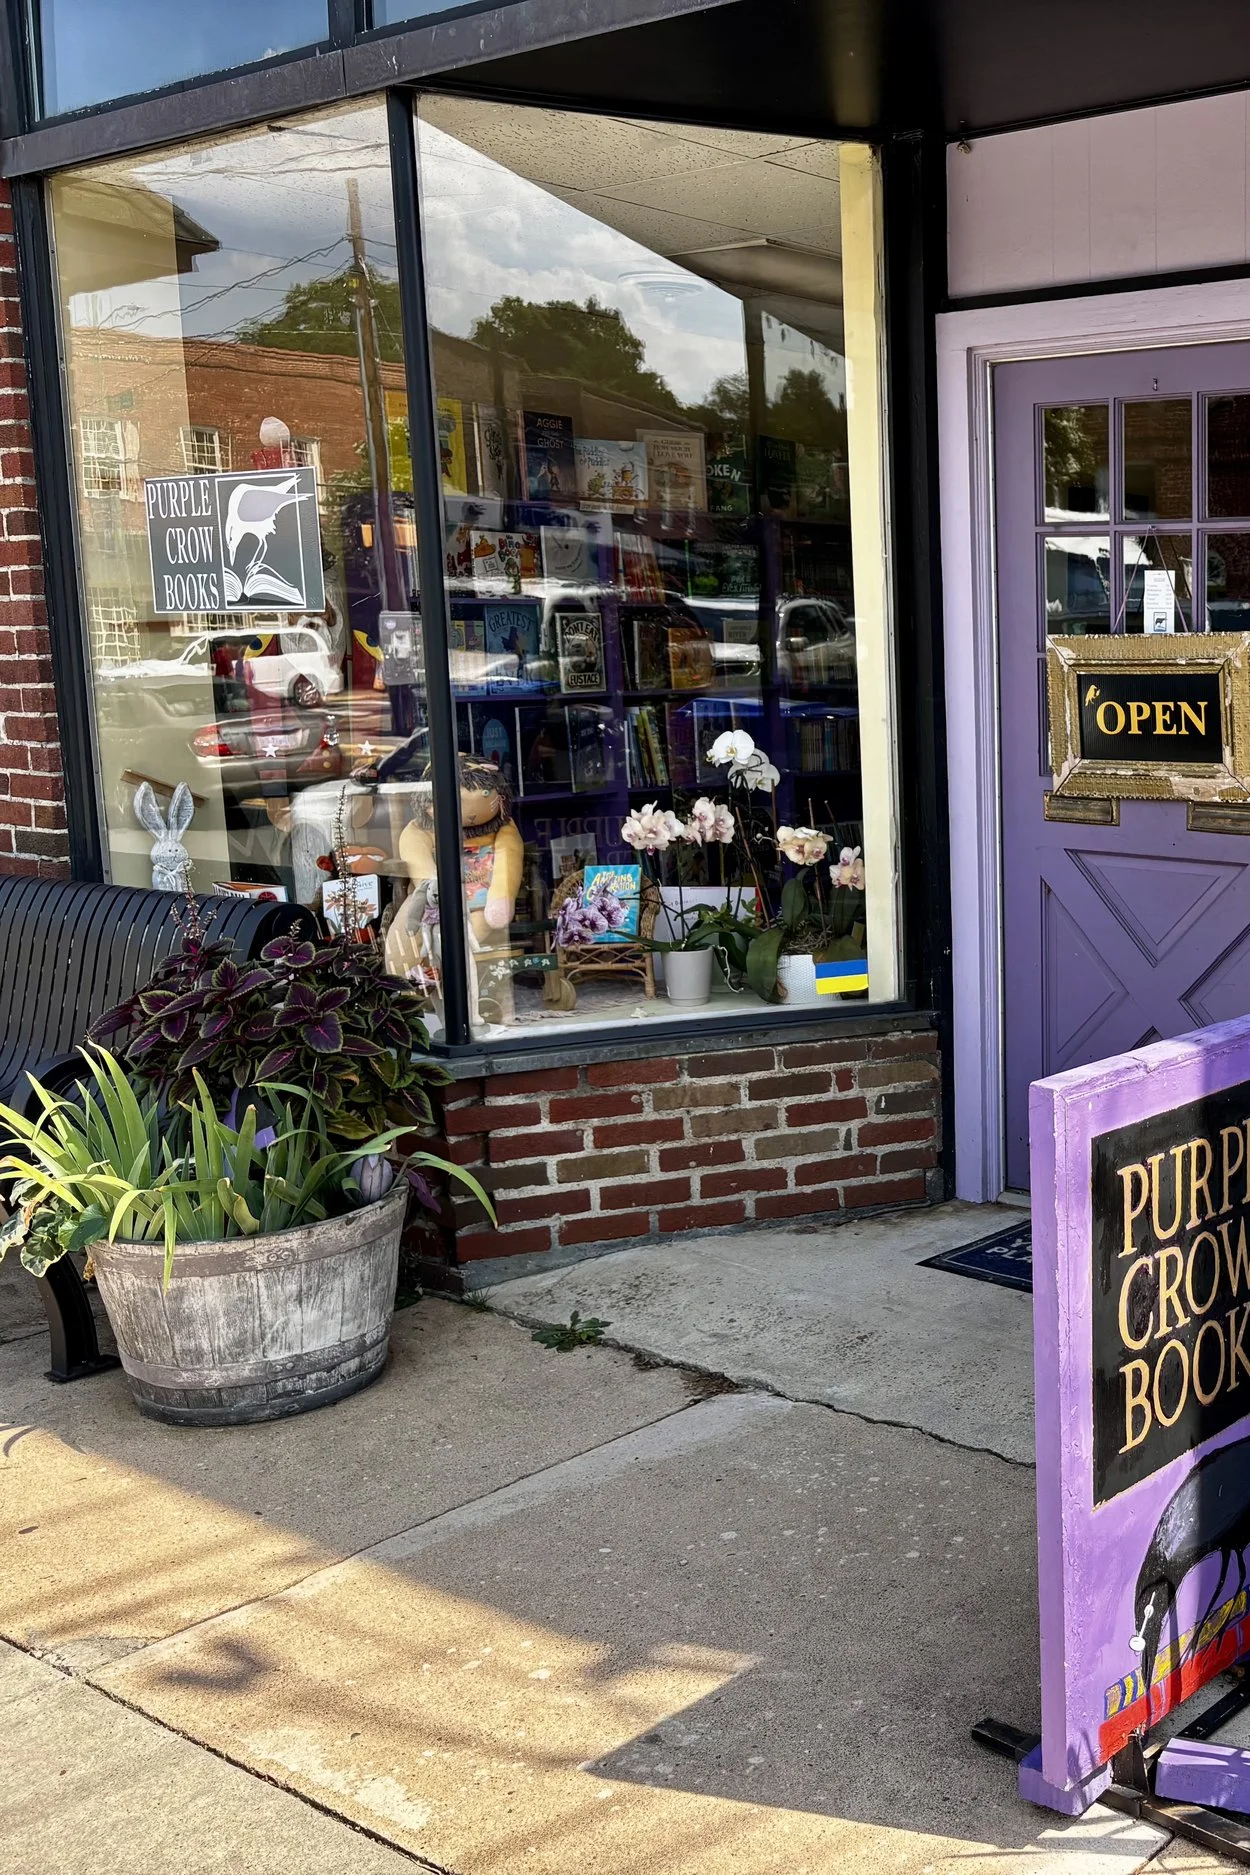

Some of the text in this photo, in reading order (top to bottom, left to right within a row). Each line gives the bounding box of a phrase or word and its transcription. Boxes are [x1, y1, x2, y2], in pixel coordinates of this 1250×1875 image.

[147, 479, 212, 519] PURPLE
[165, 526, 214, 565] CROW
[163, 573, 220, 610] BOOKS
[488, 609, 534, 634] GREATEST
[570, 673, 598, 685] EUSTACE
[1096, 701, 1208, 736] OPEN
